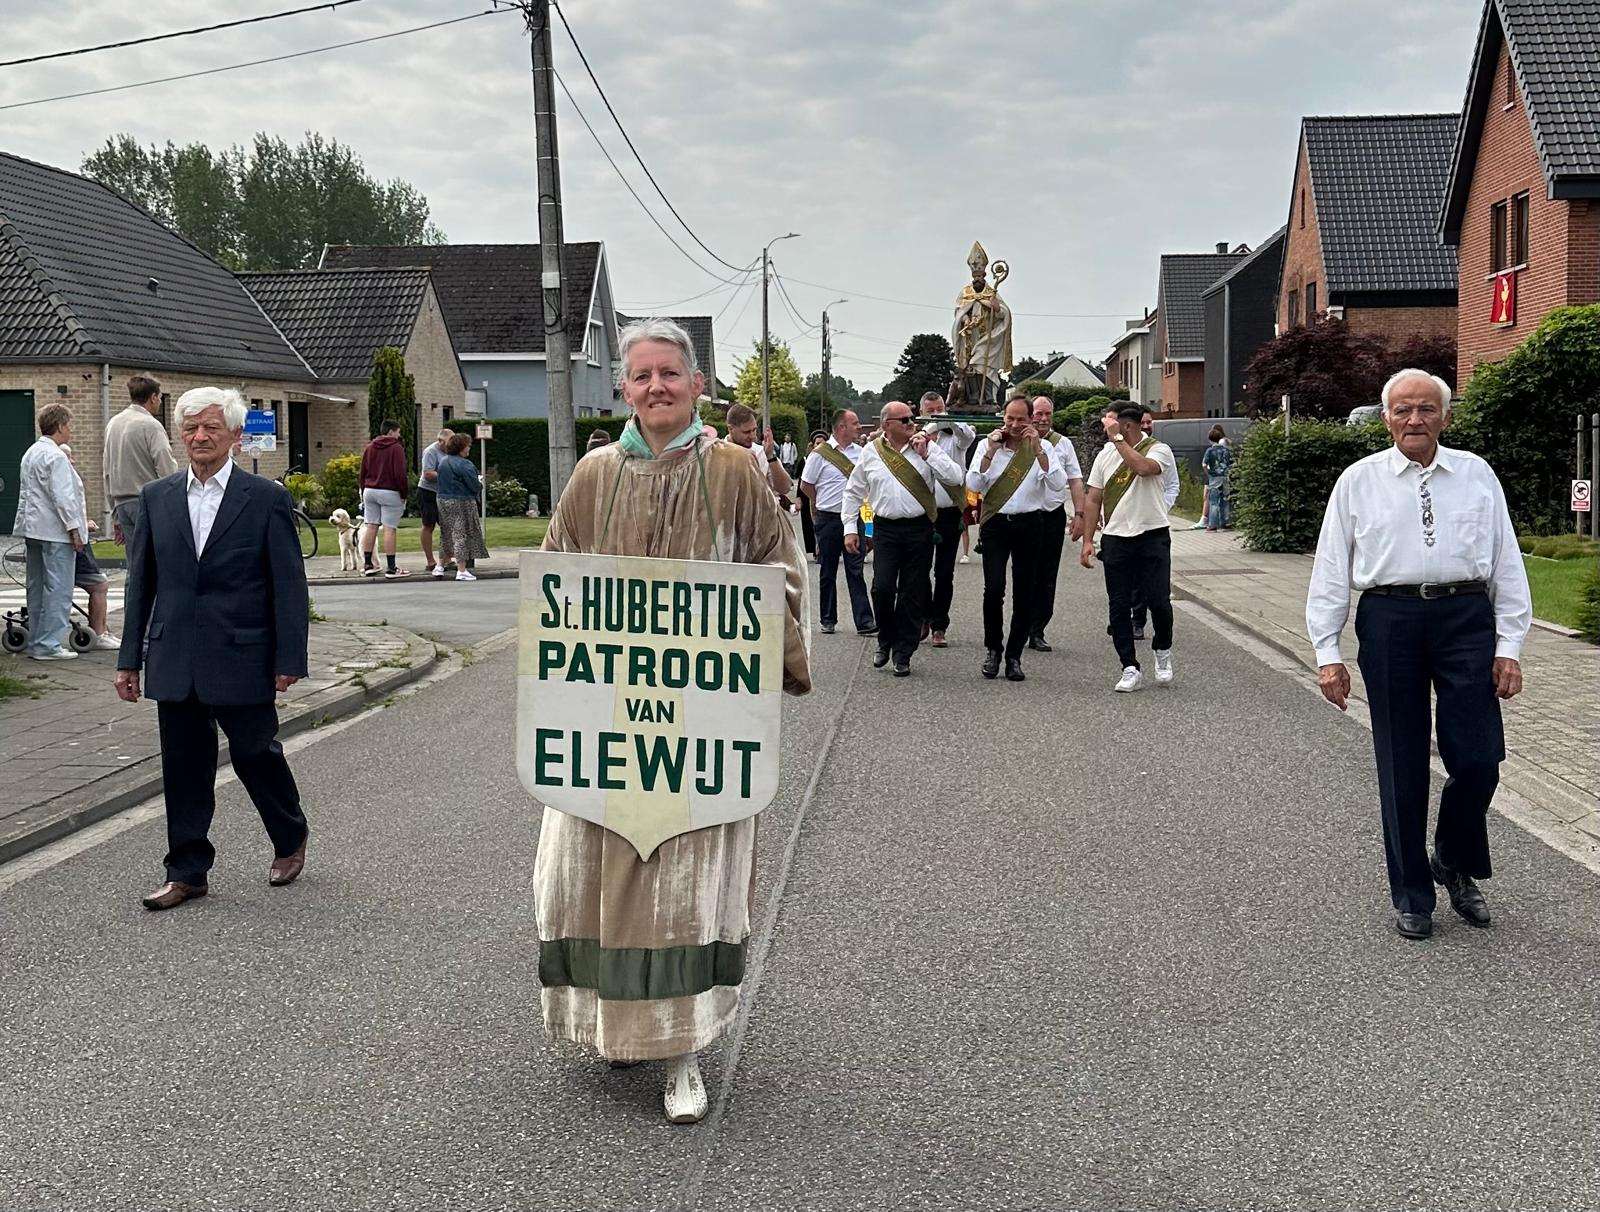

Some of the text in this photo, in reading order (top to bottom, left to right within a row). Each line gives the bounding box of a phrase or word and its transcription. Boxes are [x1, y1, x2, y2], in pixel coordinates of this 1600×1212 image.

[538, 640, 761, 694] PATROON
[625, 698, 675, 723] VAN
[535, 728, 761, 798] ELEWIJT
